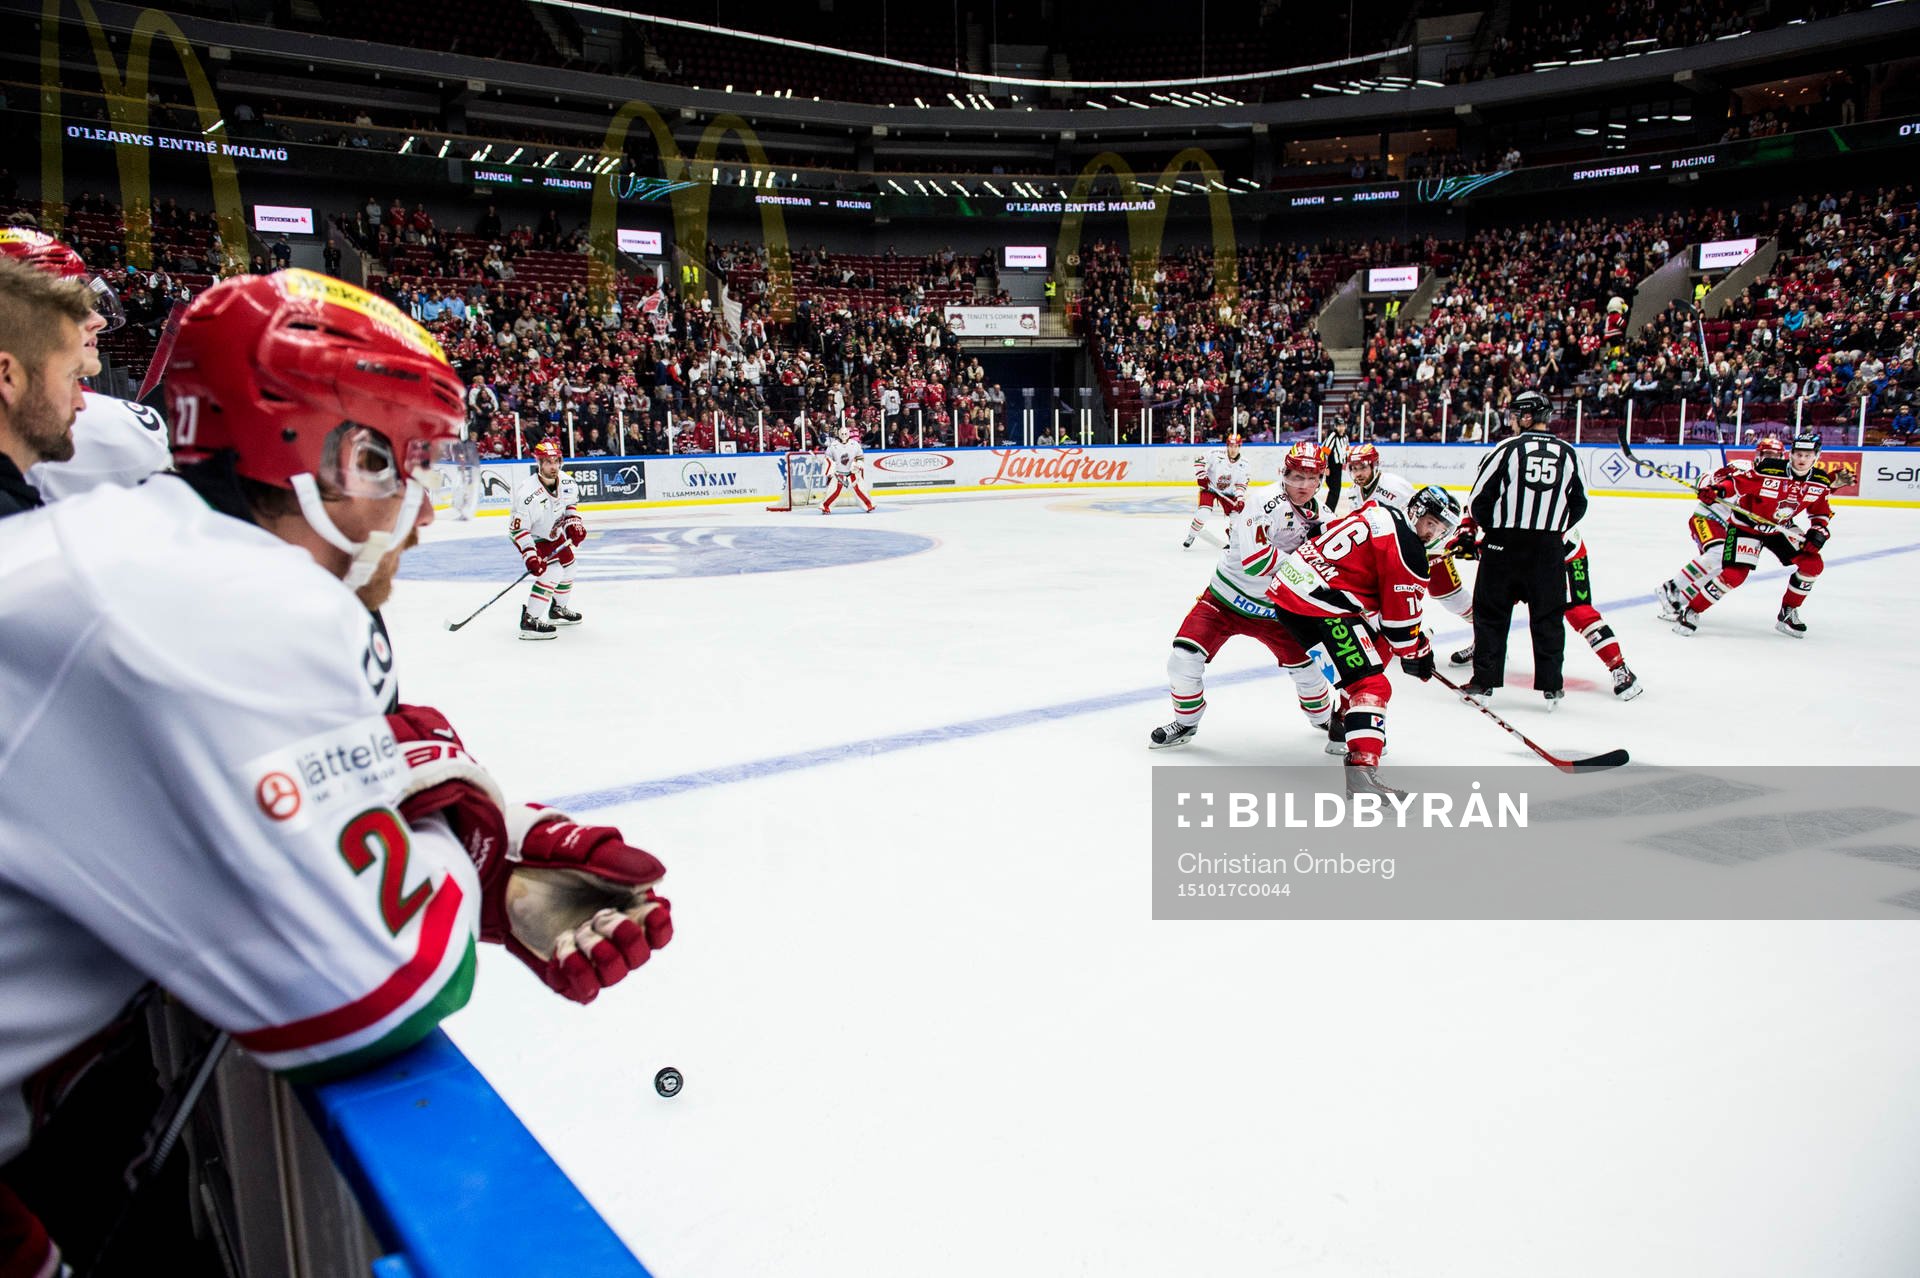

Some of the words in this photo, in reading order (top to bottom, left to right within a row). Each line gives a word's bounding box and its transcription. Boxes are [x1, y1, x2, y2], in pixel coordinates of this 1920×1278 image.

[66, 126, 154, 147] O'LEARYS
[158, 137, 218, 154] ENTRÉ
[222, 143, 289, 161] MALMÖ
[1573, 164, 1640, 181] SPORTSBAR
[1671, 154, 1716, 170] RACING
[474, 170, 513, 183] LUNCH
[543, 177, 593, 190] JULBORD
[755, 195, 812, 206] SPORTSBAR
[836, 200, 872, 210] RACING
[1006, 202, 1062, 212] O'LEARYS
[1064, 201, 1106, 213] ENTRÉ
[1108, 199, 1156, 212] MALMÖ
[1290, 195, 1326, 207] LUNCH
[1352, 190, 1400, 202] JULBORD
[979, 448, 1130, 486] Landgren
[1524, 456, 1558, 484] 55
[1635, 459, 1700, 480] Ocab
[604, 473, 625, 485] LA
[605, 484, 632, 493] Travel
[689, 472, 737, 487] SYSAV
[661, 490, 710, 498] TILLSAMMANS
[1314, 515, 1369, 561] 16
[338, 806, 433, 938] 2
